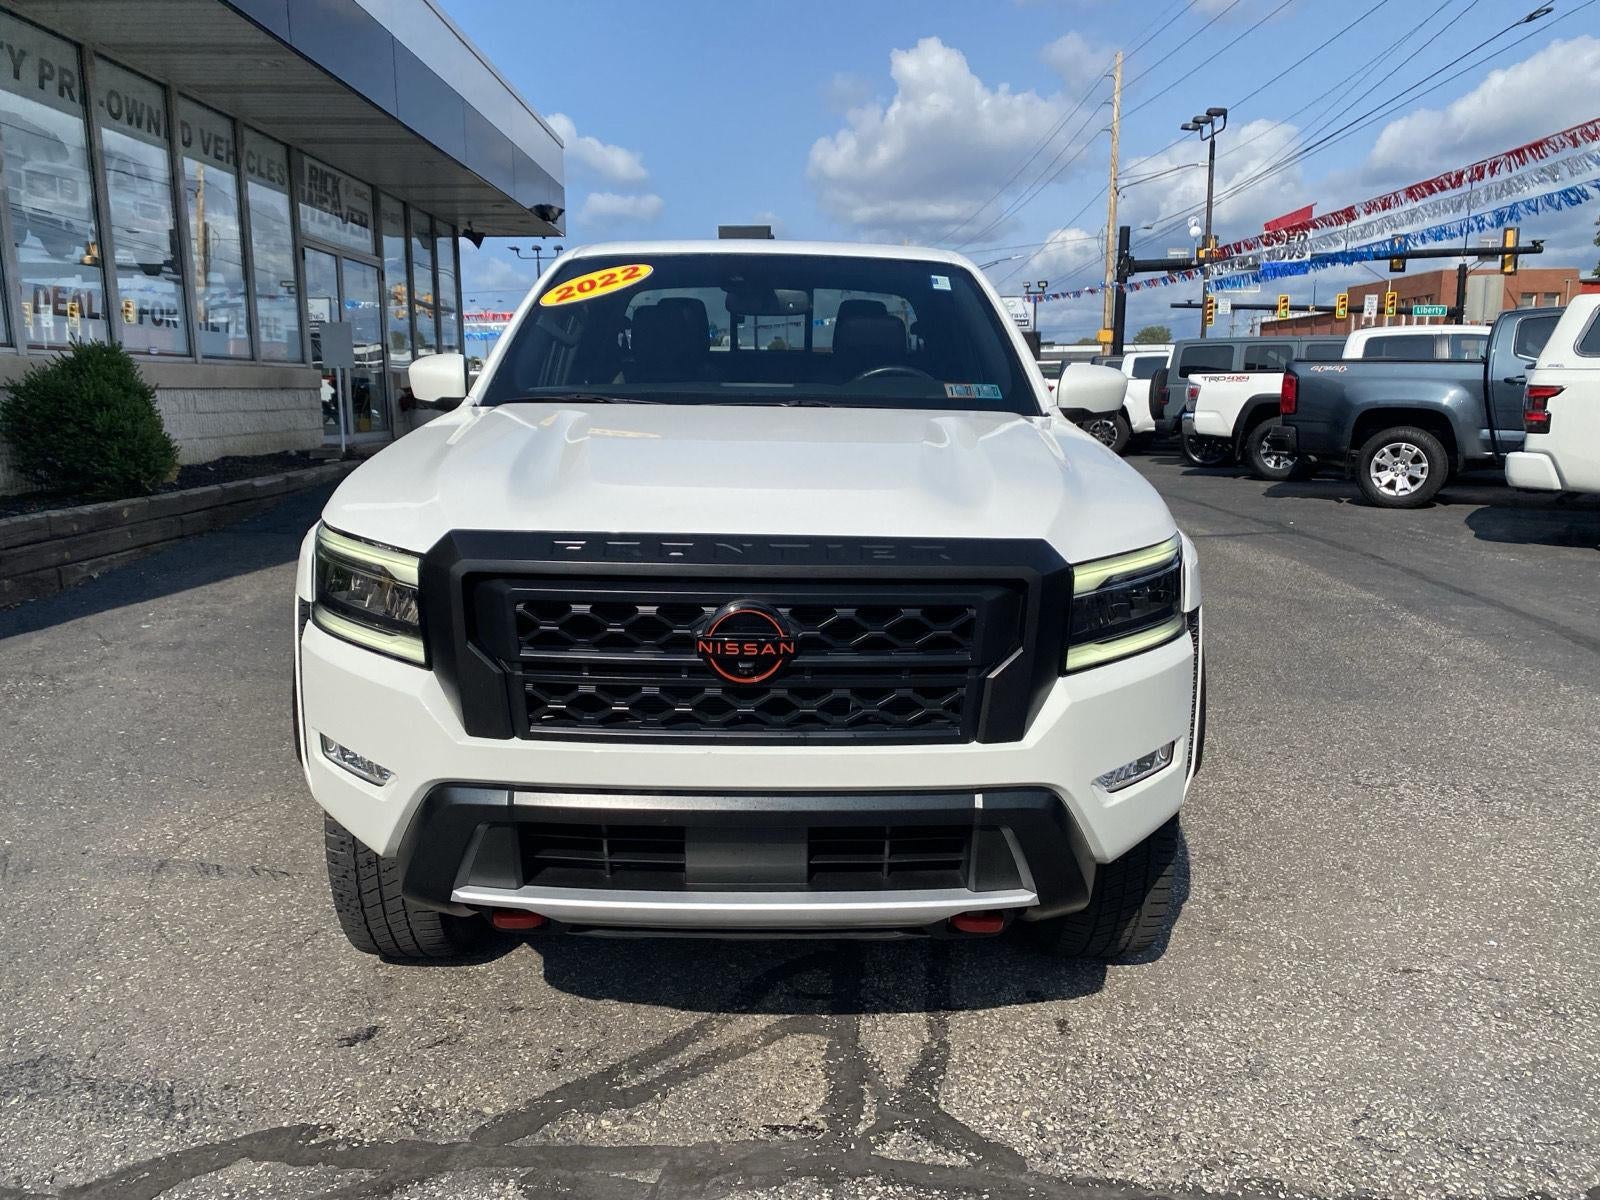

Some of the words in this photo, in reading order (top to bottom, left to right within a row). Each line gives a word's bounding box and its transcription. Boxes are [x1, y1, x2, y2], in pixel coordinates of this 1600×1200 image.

[0, 40, 27, 81] Y
[200, 127, 286, 187] VEHCLES
[555, 264, 642, 304] 2022
[1416, 306, 1443, 315] Liberty
[1201, 375, 1227, 383] TRD
[550, 539, 951, 563] FRONTIER
[697, 640, 795, 656] NISSAN
